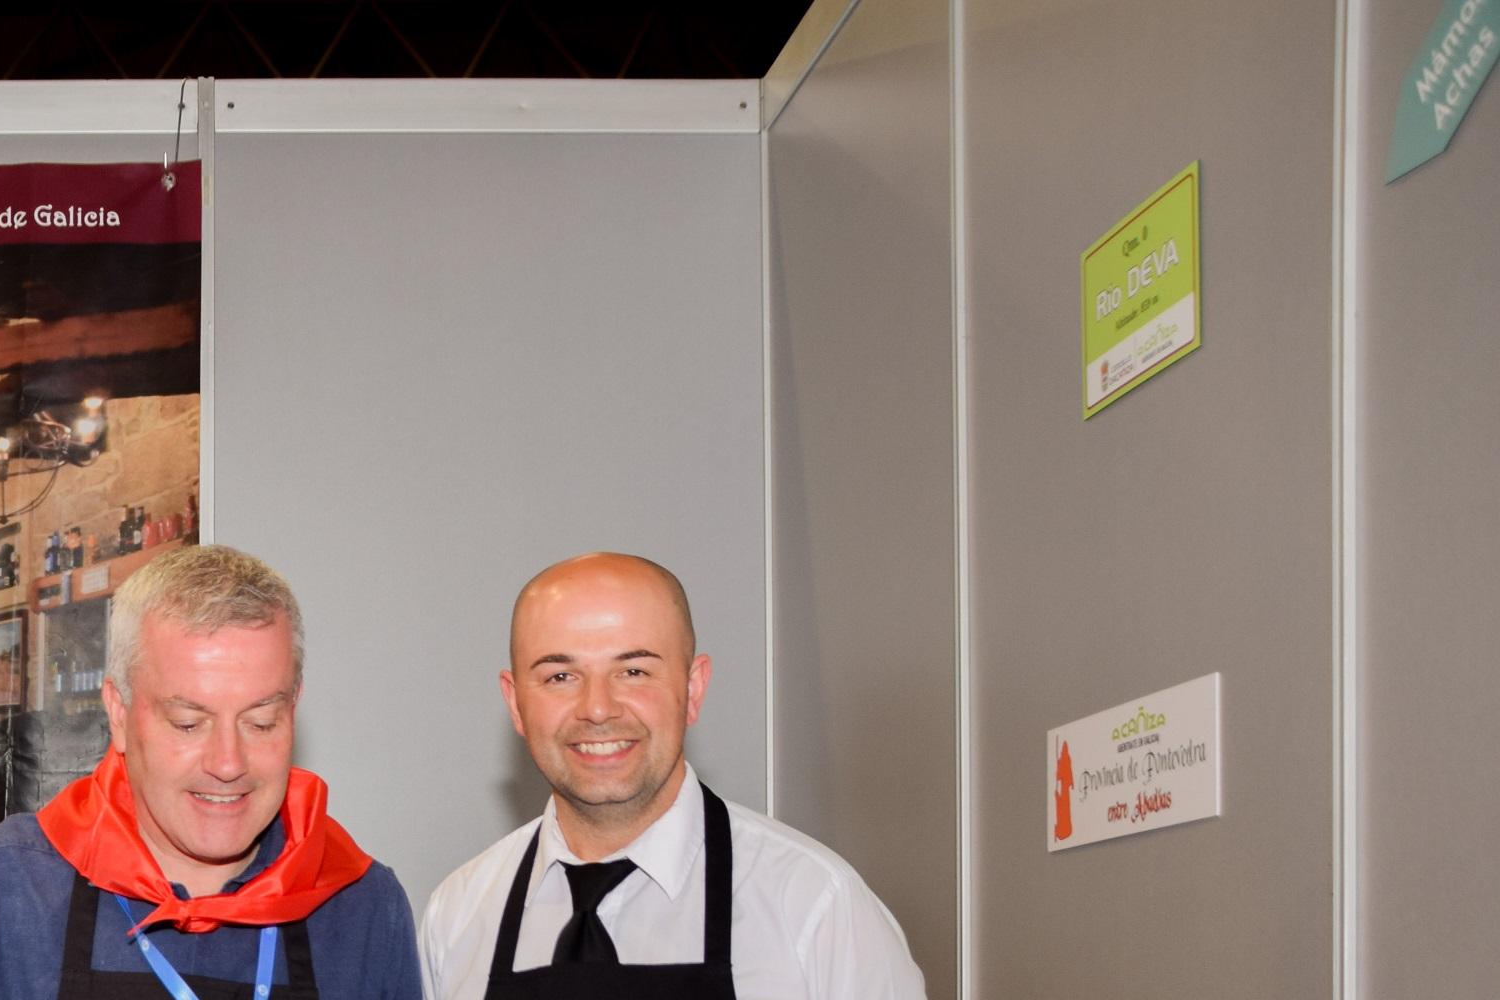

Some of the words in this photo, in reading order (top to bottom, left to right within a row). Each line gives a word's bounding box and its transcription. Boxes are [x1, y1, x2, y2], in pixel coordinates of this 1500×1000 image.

[1434, 26, 1494, 130] Achas
[34, 203, 121, 228] Galicia
[1127, 238, 1179, 299] DEVA
